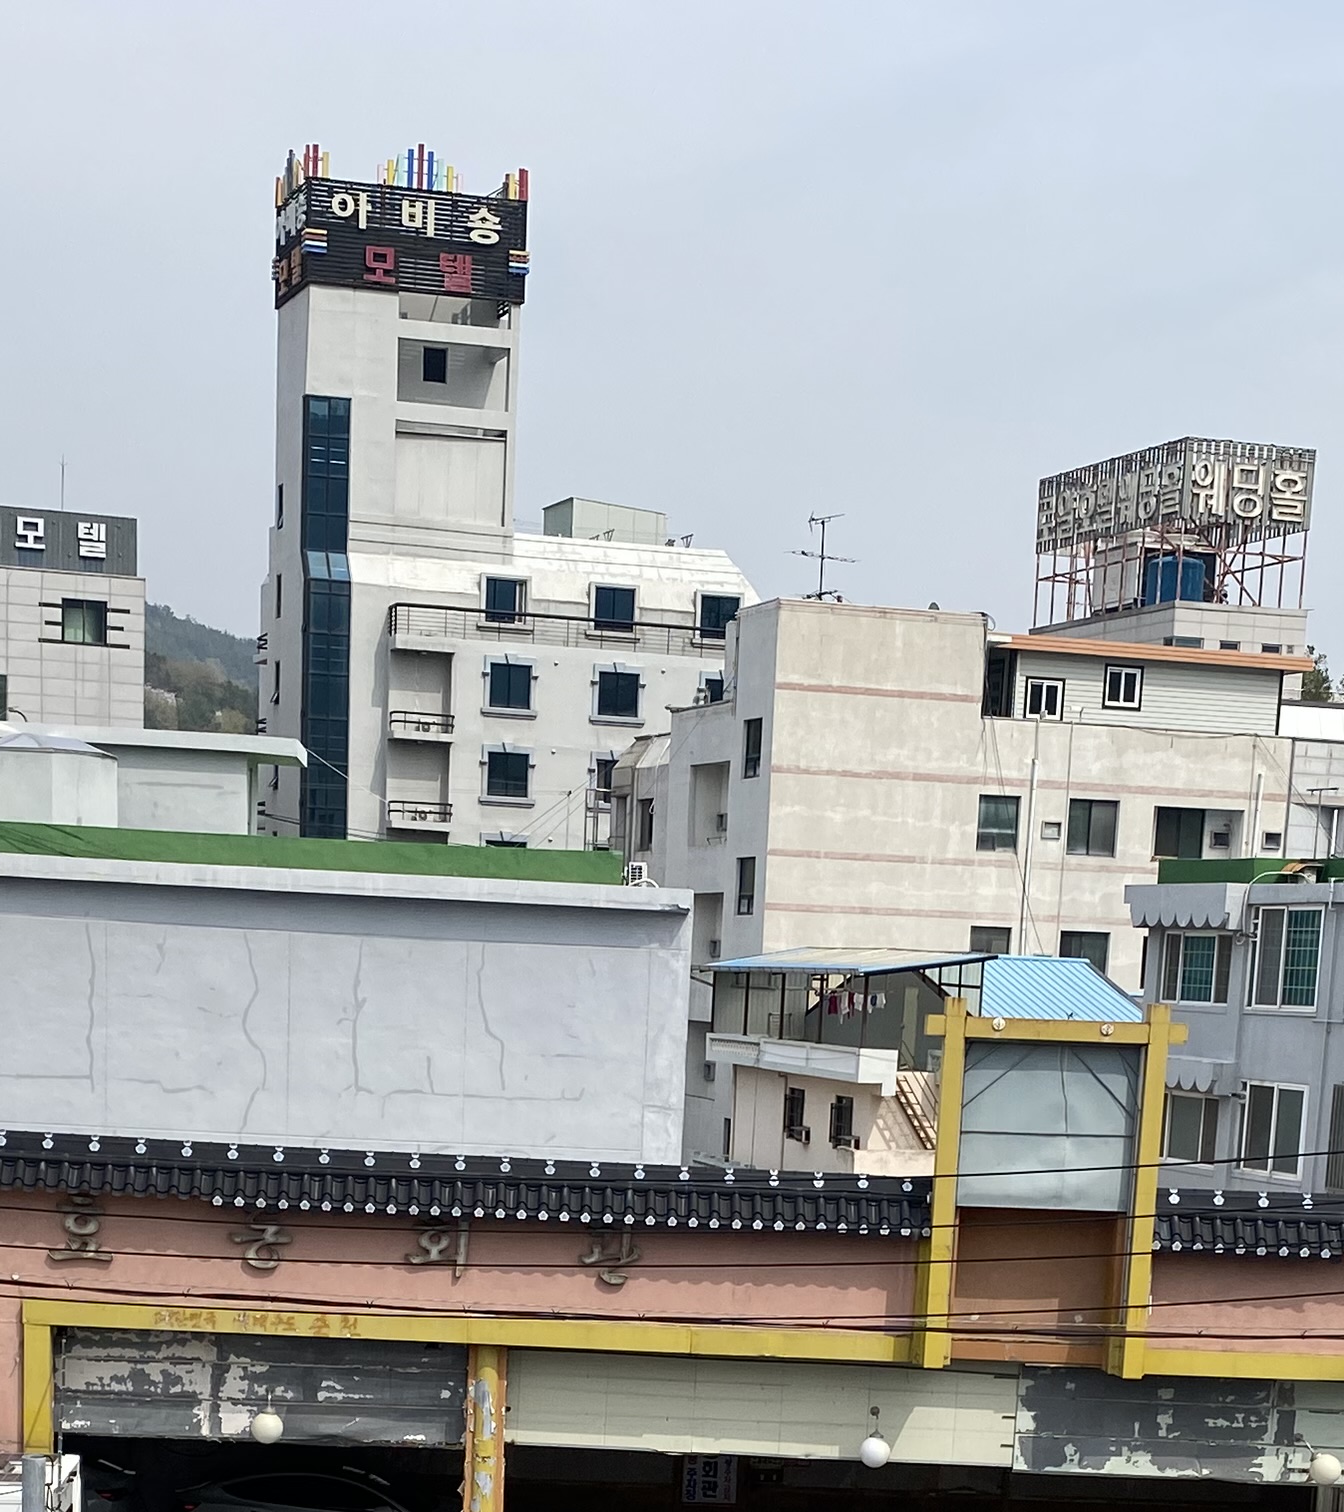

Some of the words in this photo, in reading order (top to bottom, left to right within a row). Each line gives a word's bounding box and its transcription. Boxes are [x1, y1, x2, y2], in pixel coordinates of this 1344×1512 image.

[331, 191, 503, 245] 아비송
[362, 245, 473, 293] 모텔
[14, 515, 106, 559] 모텔
